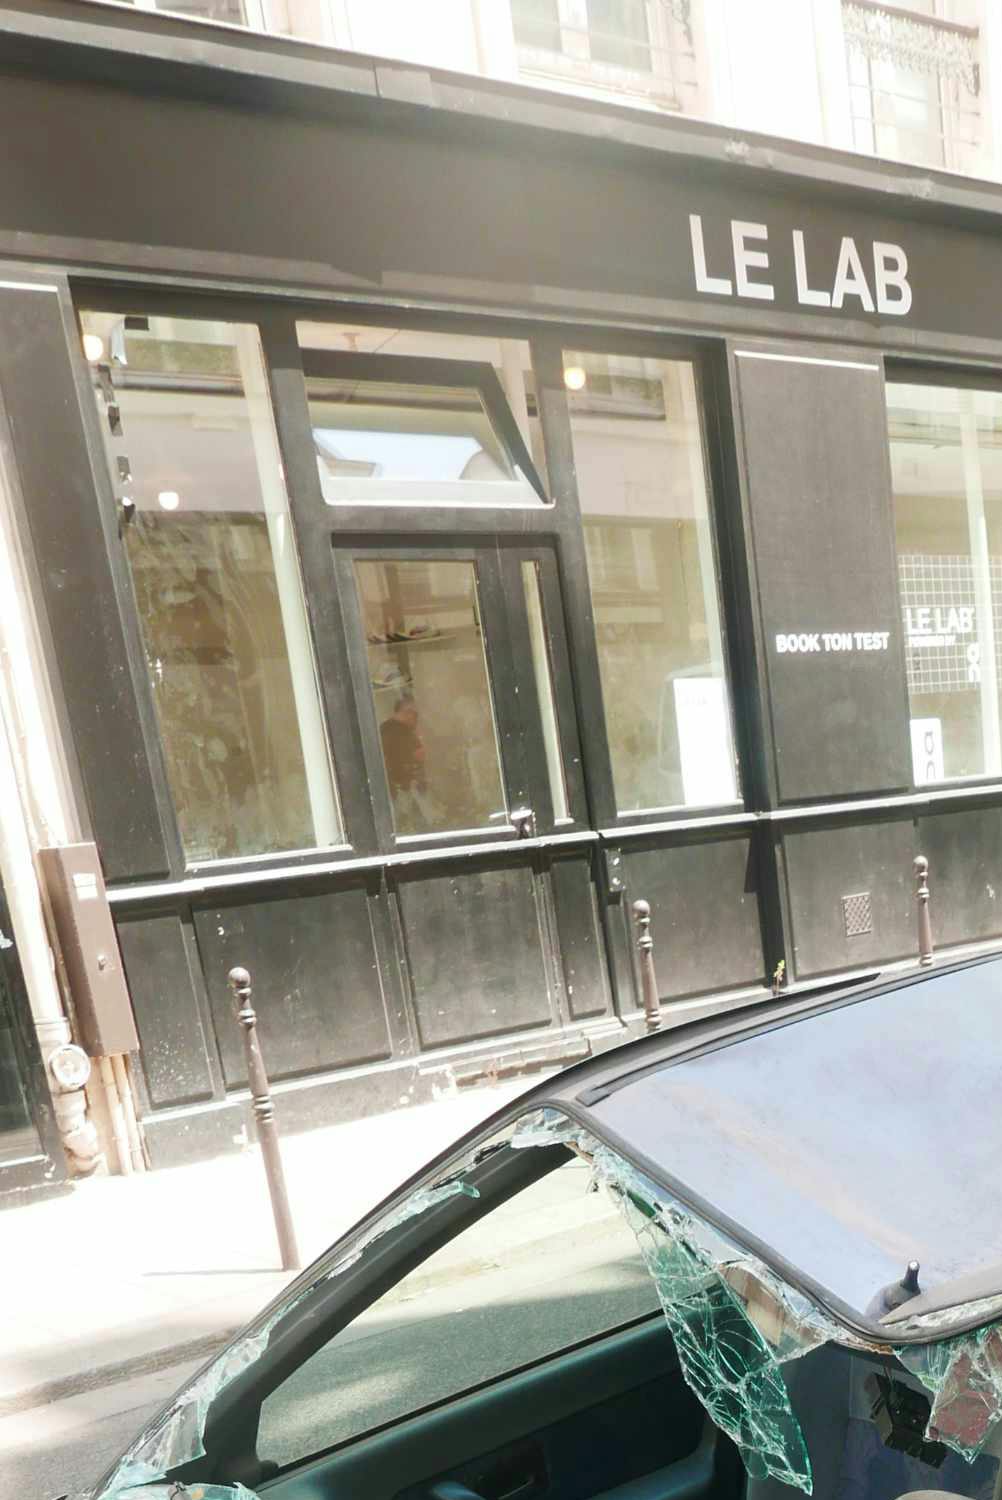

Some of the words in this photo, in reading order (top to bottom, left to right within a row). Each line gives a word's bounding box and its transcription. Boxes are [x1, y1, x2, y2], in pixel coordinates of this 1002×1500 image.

[689, 213, 775, 301] LE
[792, 229, 913, 316] LAB
[906, 607, 933, 635] LE
[935, 607, 975, 634] LAB
[775, 633, 821, 653] BOOK
[821, 632, 853, 651] TON
[853, 631, 890, 651] TEST
